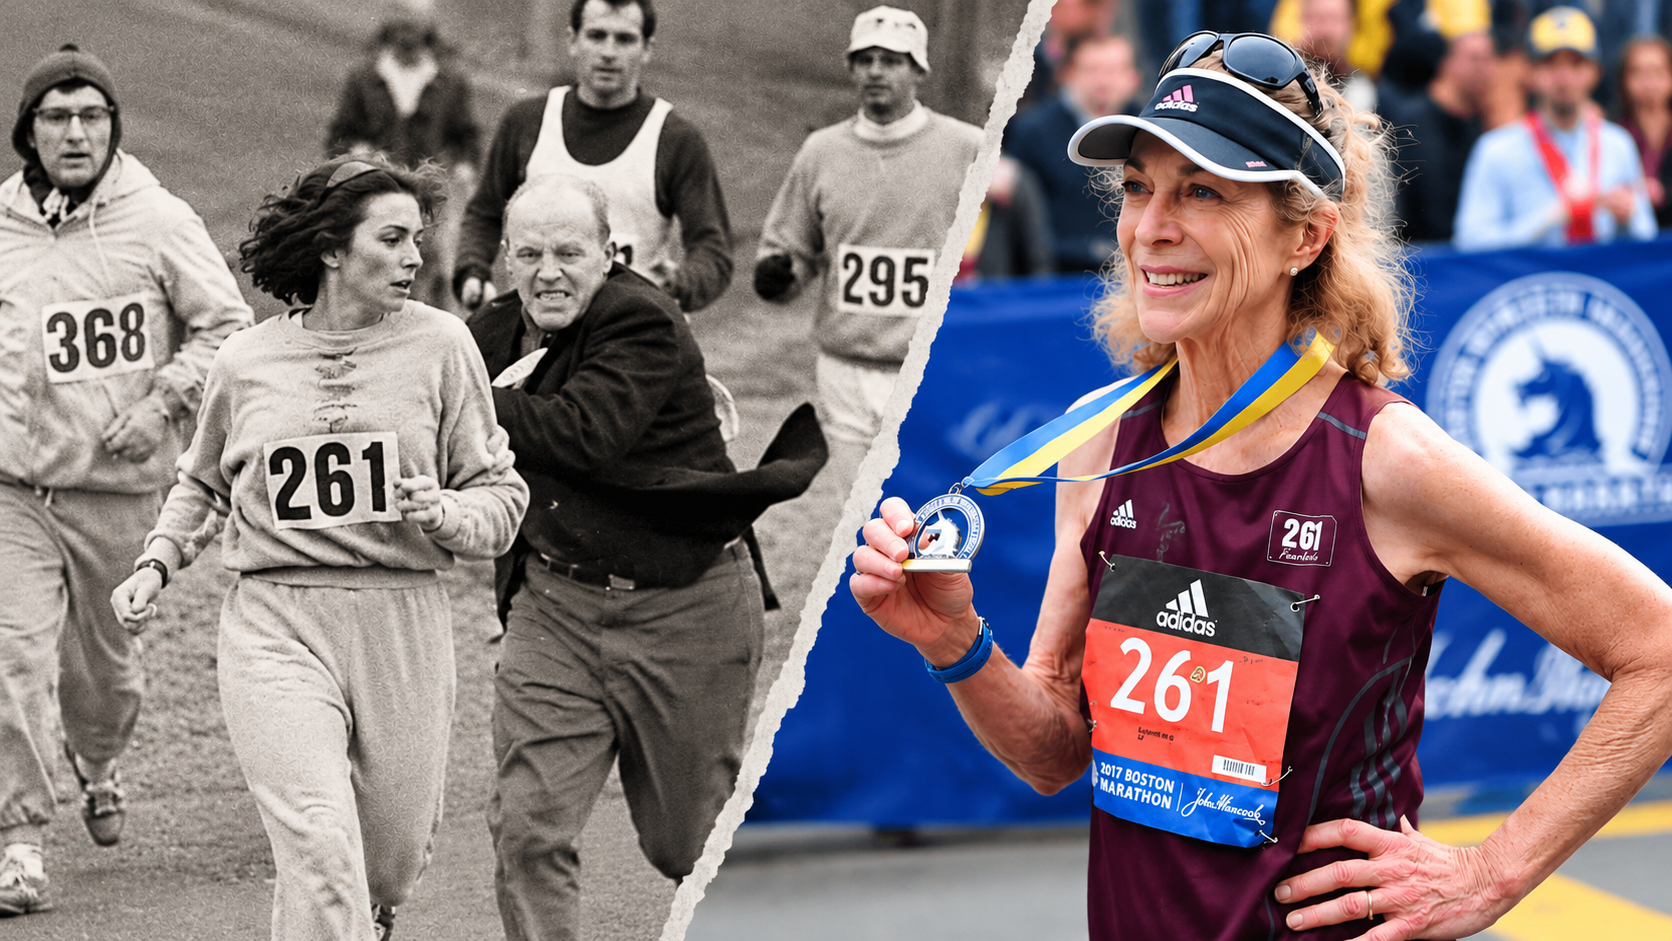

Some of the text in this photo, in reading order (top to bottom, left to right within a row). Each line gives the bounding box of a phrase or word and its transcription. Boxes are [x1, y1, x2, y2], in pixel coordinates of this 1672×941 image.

[1154, 99, 1198, 113] adidas
[843, 252, 929, 308] 295
[47, 302, 146, 373] 368
[268, 441, 388, 522] 261
[1109, 514, 1137, 529] adidas
[1281, 518, 1323, 551] 261
[1156, 609, 1216, 637] adidas
[1110, 637, 1234, 733] 261
[1100, 762, 1175, 794] 2017 BOSTON
[1100, 777, 1172, 809] MARATHON
